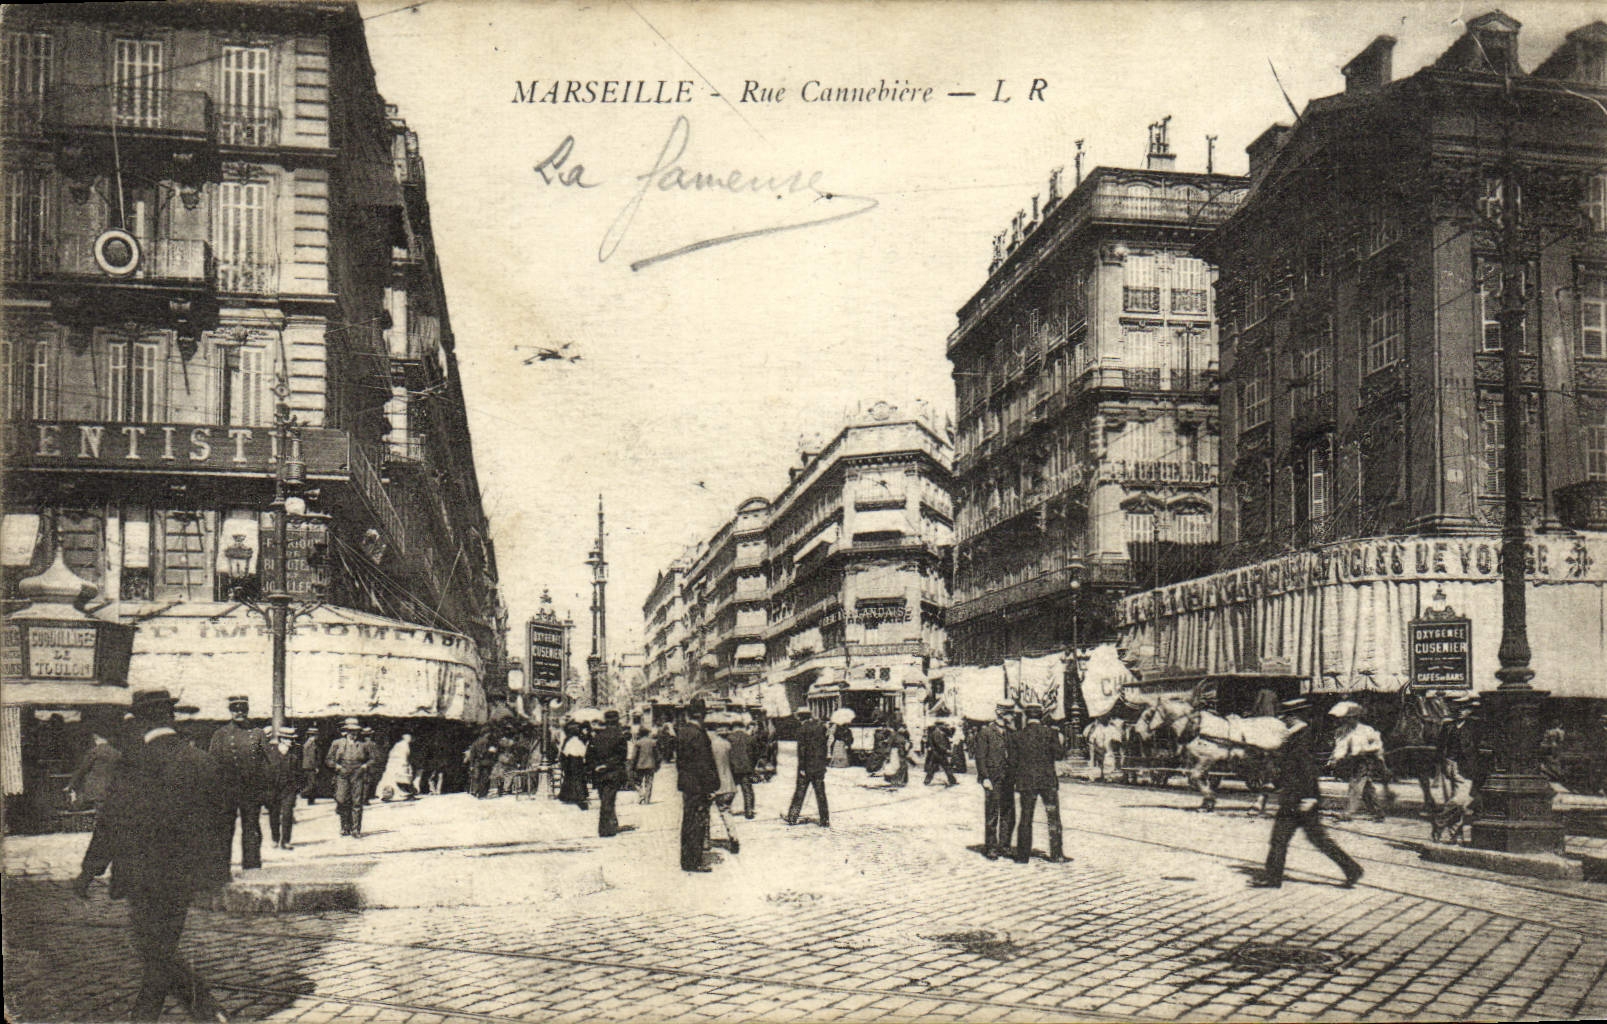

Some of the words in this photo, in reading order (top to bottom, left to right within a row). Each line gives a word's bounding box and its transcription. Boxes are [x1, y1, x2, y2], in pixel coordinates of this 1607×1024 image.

[534, 134, 602, 190] La
[1415, 541, 1448, 575] DE
[1458, 541, 1550, 575] VOGE
[1415, 641, 1468, 654] CUSENIER
